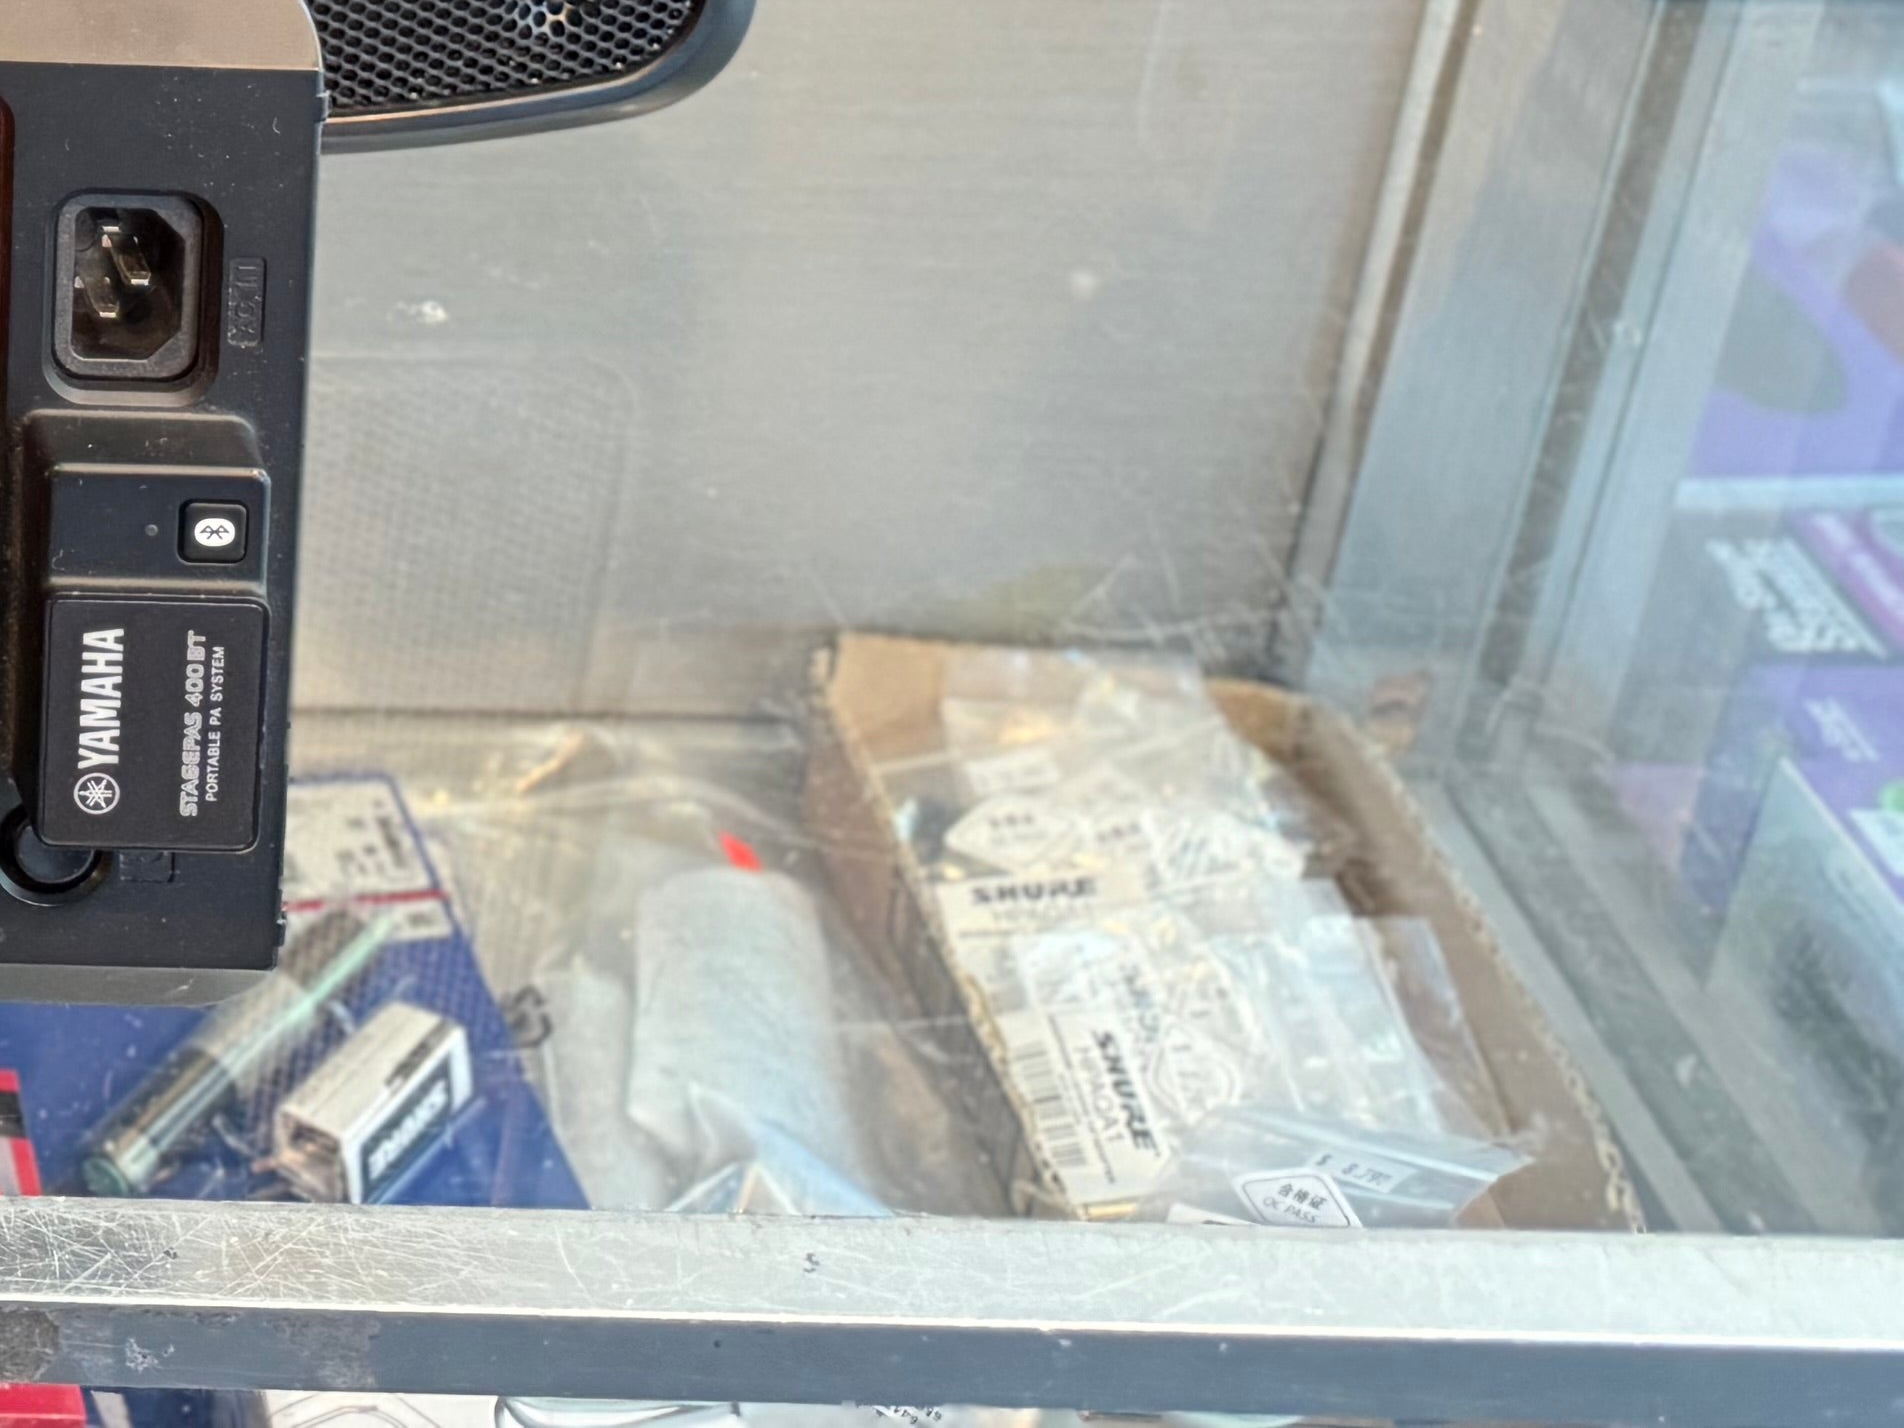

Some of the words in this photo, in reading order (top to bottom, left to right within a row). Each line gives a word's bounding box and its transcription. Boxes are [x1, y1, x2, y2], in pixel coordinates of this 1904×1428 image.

[187, 629, 207, 662] BT
[77, 628, 125, 769] YAMAHA
[185, 663, 205, 707] 400
[211, 645, 225, 702] SYSTEM
[210, 707, 222, 726] PA
[179, 711, 203, 817] STAGEPAS
[205, 731, 221, 802] PORTABLE
[972, 877, 1097, 905] SHURE
[1092, 1031, 1157, 1151] SHURE
[1284, 1204, 1319, 1224] PASS
